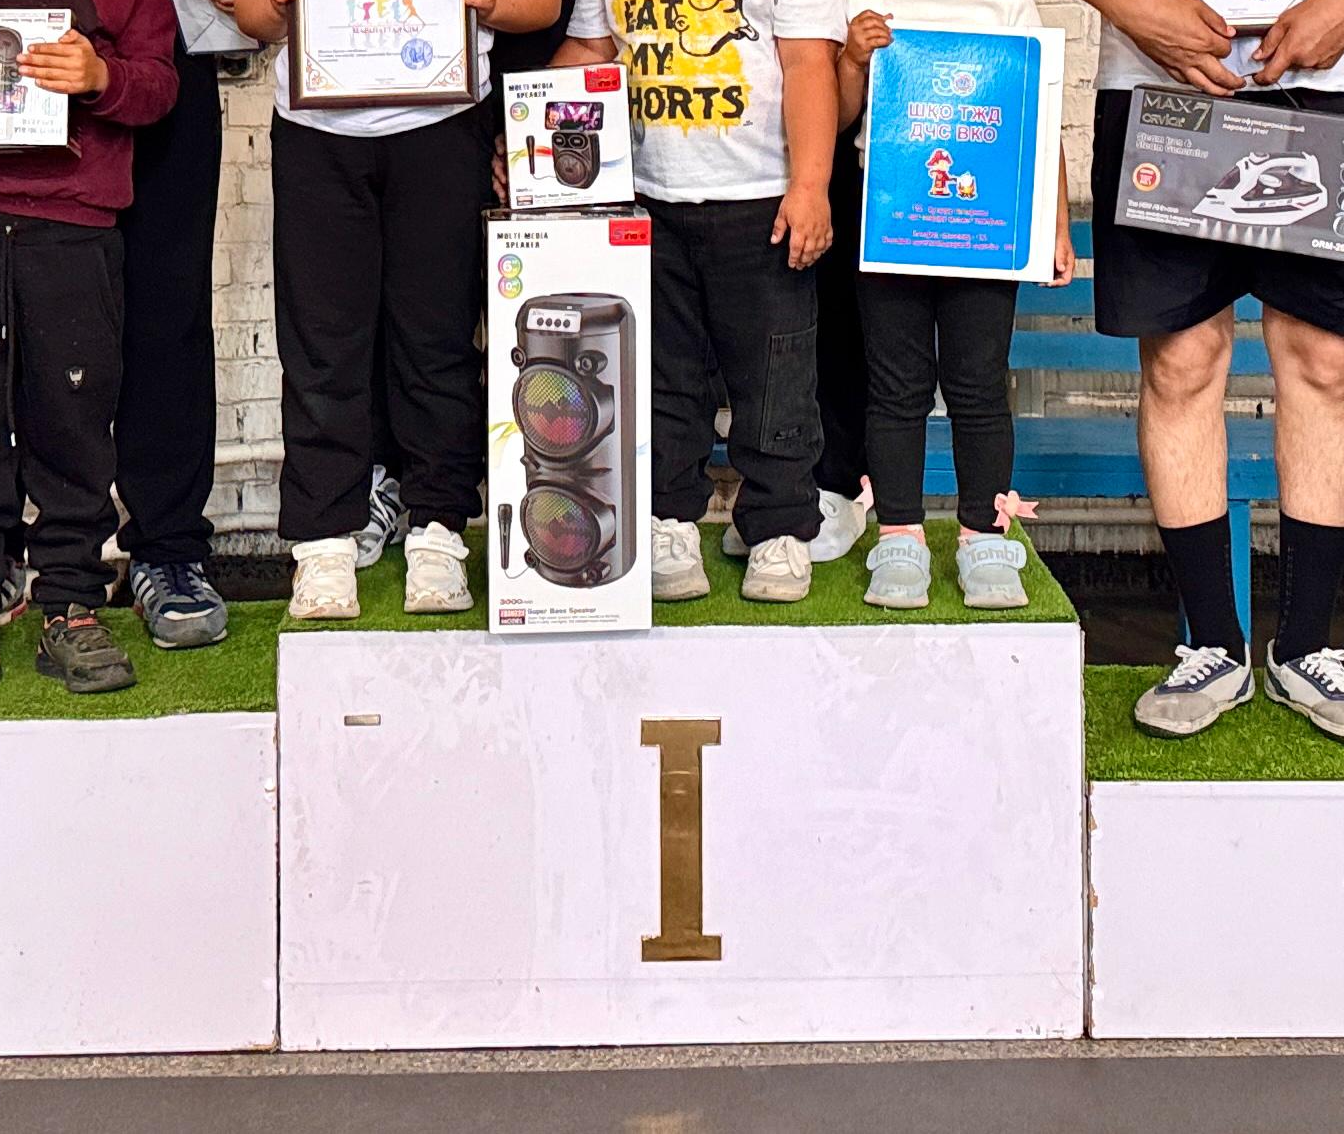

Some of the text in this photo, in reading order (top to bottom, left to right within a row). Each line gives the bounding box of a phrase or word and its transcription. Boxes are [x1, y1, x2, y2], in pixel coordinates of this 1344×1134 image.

[629, 43, 674, 76] MY
[630, 84, 745, 121] HORTS
[1143, 94, 1212, 131] MAX 7
[958, 105, 1002, 126] ТЖД
[909, 122, 997, 143] ДЧС ВКО
[524, 232, 548, 240] MEDIA
[875, 544, 923, 563] Tombi
[966, 544, 1020, 564] Tombi
